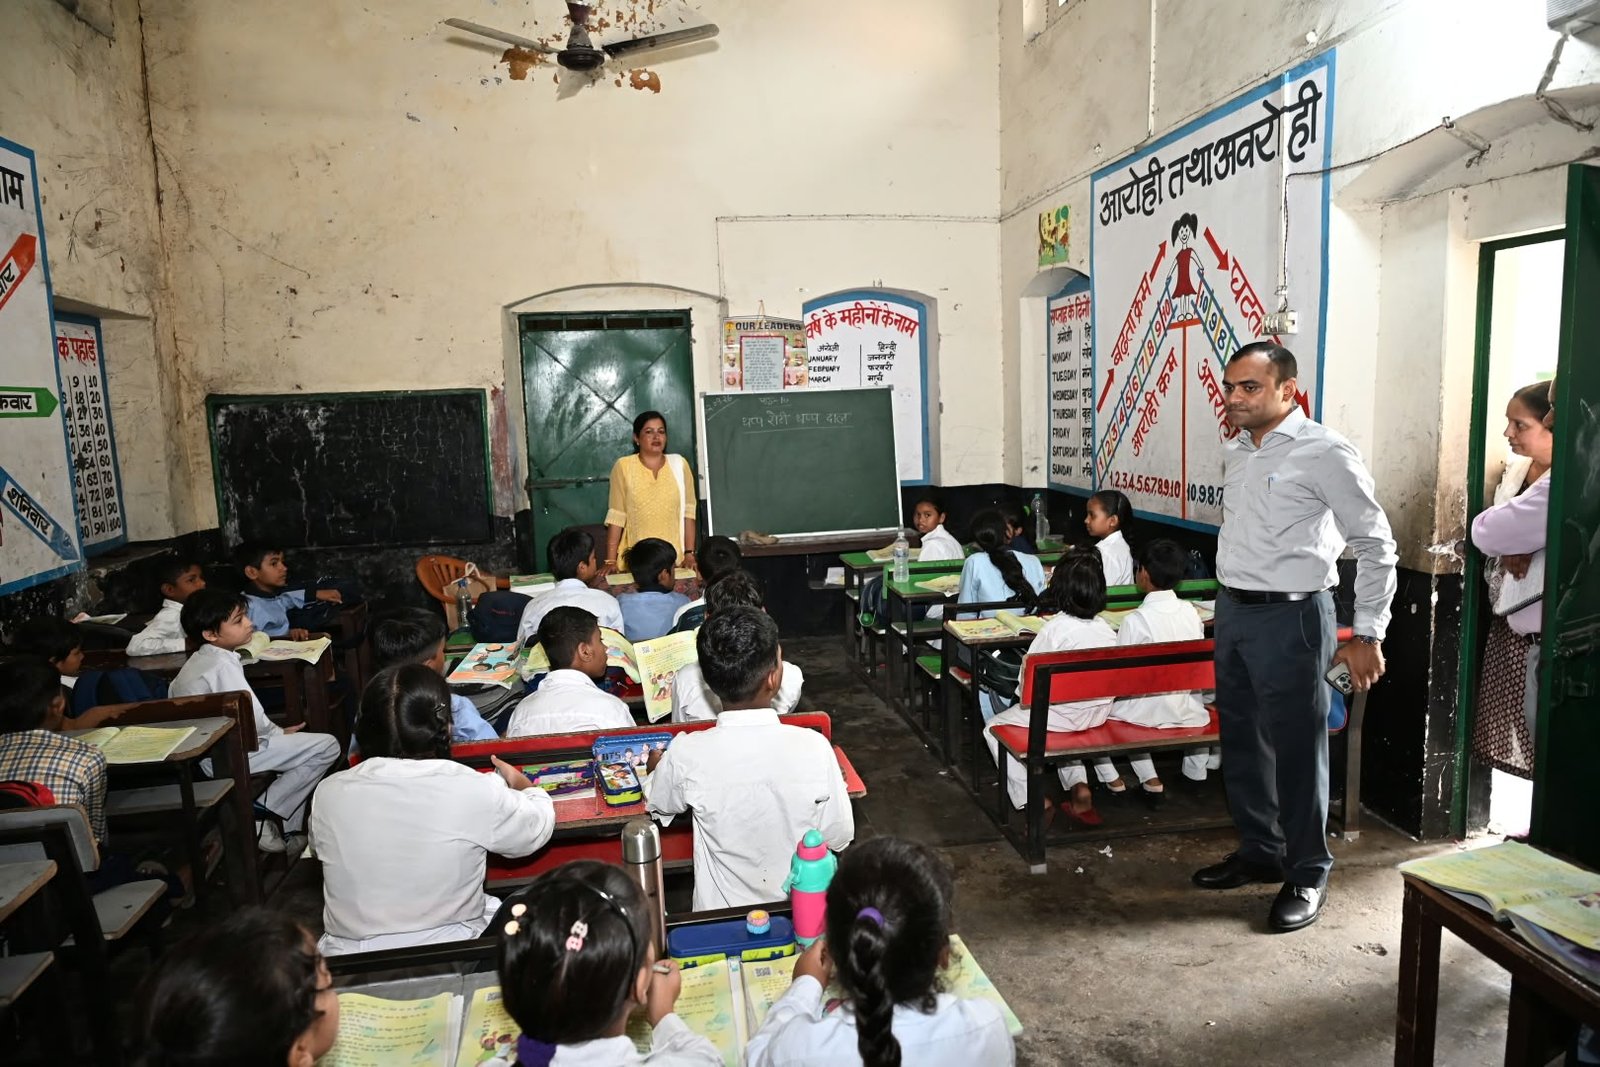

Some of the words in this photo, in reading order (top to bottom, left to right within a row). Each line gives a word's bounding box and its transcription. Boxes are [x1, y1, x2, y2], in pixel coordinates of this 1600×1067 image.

[1100, 156, 1165, 226] आरोही
[1168, 143, 1214, 199] तथा
[1213, 79, 1322, 181] अवरोही
[0, 165, 25, 210] ाम
[1131, 271, 1152, 324] क्रम
[1230, 255, 1266, 339] घटत
[735, 322, 756, 331] OUR
[757, 322, 802, 331] LEADERS
[806, 313, 822, 339] वर्ष
[822, 309, 838, 330] के
[838, 301, 882, 329] महीनों
[880, 303, 895, 328] के
[893, 313, 920, 339] नाम
[1199, 290, 1209, 314] 10
[1208, 312, 1218, 332] 9
[1217, 328, 1227, 351] 8
[808, 355, 838, 363] JANUARY
[1052, 351, 1072, 363] MONDAY
[72, 376, 79, 388] 9
[88, 375, 98, 388] 10
[808, 375, 832, 383] MARCH
[1052, 368, 1078, 382] TUESDAY
[1105, 440, 1112, 457] 2
[1111, 422, 1118, 441] 3
[1119, 407, 1125, 425] 4
[1126, 390, 1133, 410] 5
[1132, 375, 1139, 392] 6
[1139, 356, 1146, 374] 7
[1147, 339, 1155, 357] 8
[1154, 320, 1161, 338] 9
[1161, 298, 1171, 322] 10
[74, 391, 85, 405] 18
[90, 391, 101, 404] 20
[1052, 388, 1078, 401] WEDNESDAY
[1131, 389, 1160, 457] आरोही
[1156, 346, 1178, 398] क्रम
[92, 406, 103, 420] 30
[1052, 408, 1078, 420] THURSDAY
[78, 424, 91, 438] 36
[94, 423, 106, 437] 40
[1052, 427, 1071, 439] FRIDAY
[82, 440, 93, 454] 45
[97, 438, 108, 452] 50
[1052, 445, 1079, 458] SATURDAY
[84, 456, 96, 470] 54
[99, 454, 110, 467] 60
[1052, 463, 1073, 477] SUNDAY
[86, 472, 98, 486] 63
[101, 470, 113, 484] 70
[88, 489, 101, 502] 72
[104, 486, 115, 500] 80
[6, 486, 51, 537] शनिवार
[91, 506, 103, 519] 81
[107, 502, 118, 515] 90
[94, 521, 106, 535] 90
[109, 517, 122, 532] 100
